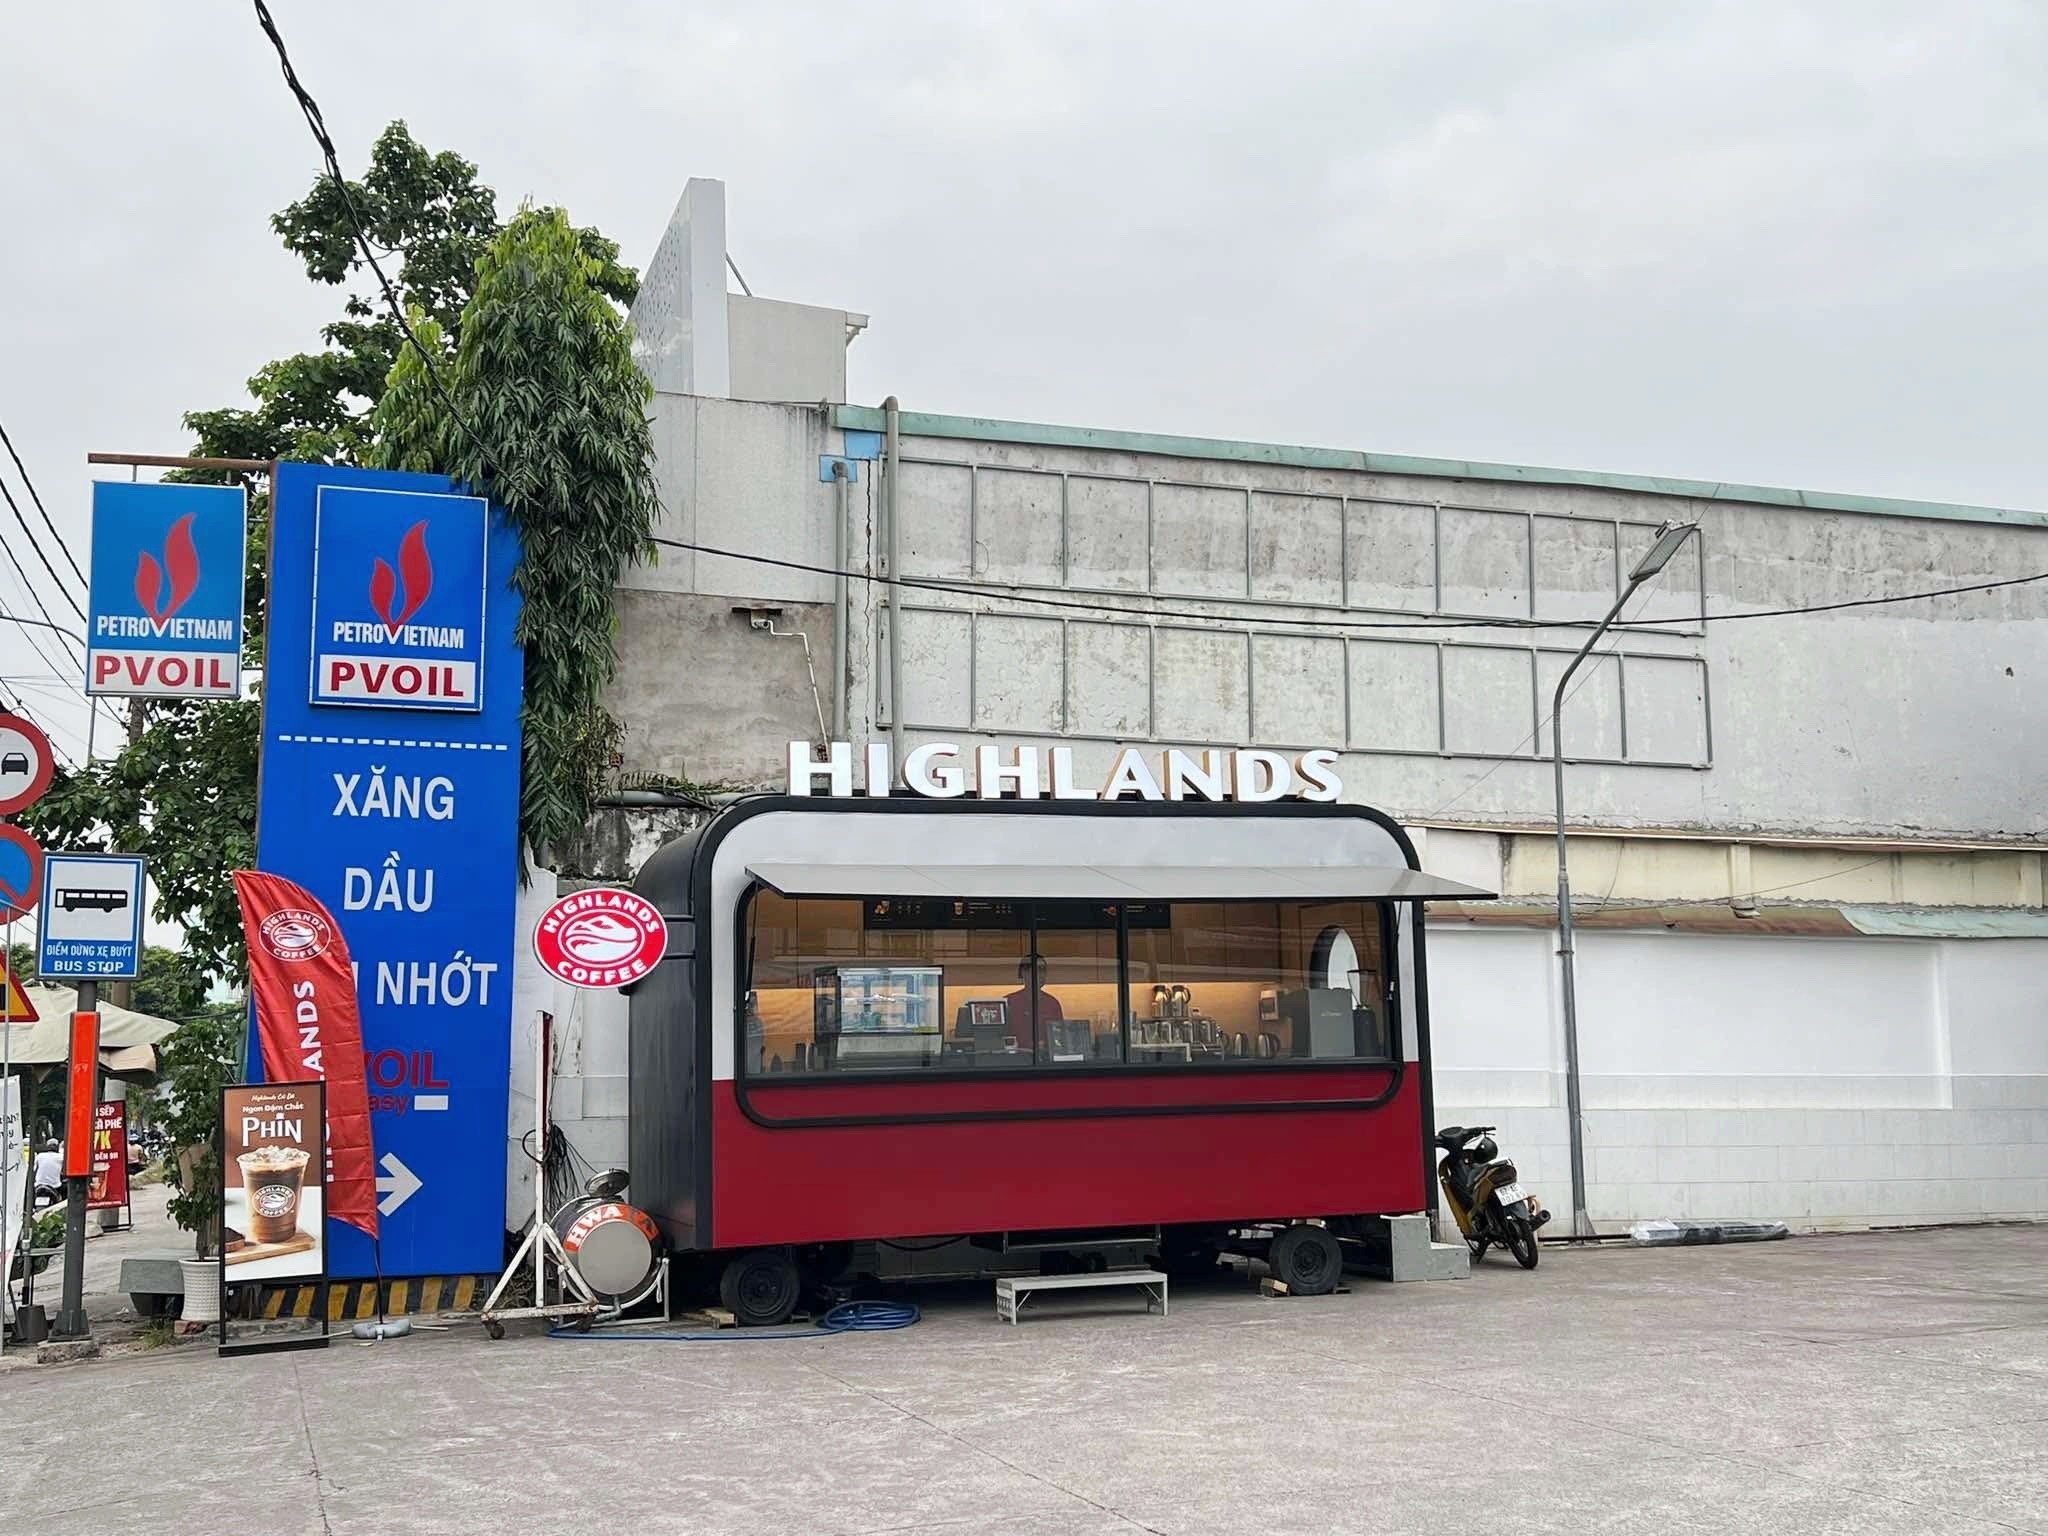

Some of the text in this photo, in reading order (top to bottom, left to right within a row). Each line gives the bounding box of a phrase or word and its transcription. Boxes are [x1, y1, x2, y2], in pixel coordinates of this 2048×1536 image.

[97, 616, 232, 640] PETROVIETNAM
[333, 622, 464, 648] PETROVIETNAM
[96, 655, 231, 688] PVOIL
[331, 662, 464, 697] PVOIL
[786, 740, 1344, 802] HIGHLANDS
[332, 765, 455, 820] XĂNG
[344, 851, 434, 912] DẦU
[262, 911, 325, 934] HIGHLANDS
[543, 894, 660, 933] HIGHLANDS
[273, 943, 322, 958] COFFEE
[54, 960, 124, 973] BUS STOP
[376, 950, 498, 1006] NHỚT
[557, 958, 647, 984] COFFEE
[363, 1049, 448, 1088] OIL
[243, 1106, 264, 1114] Ngon
[367, 1093, 409, 1116] asy
